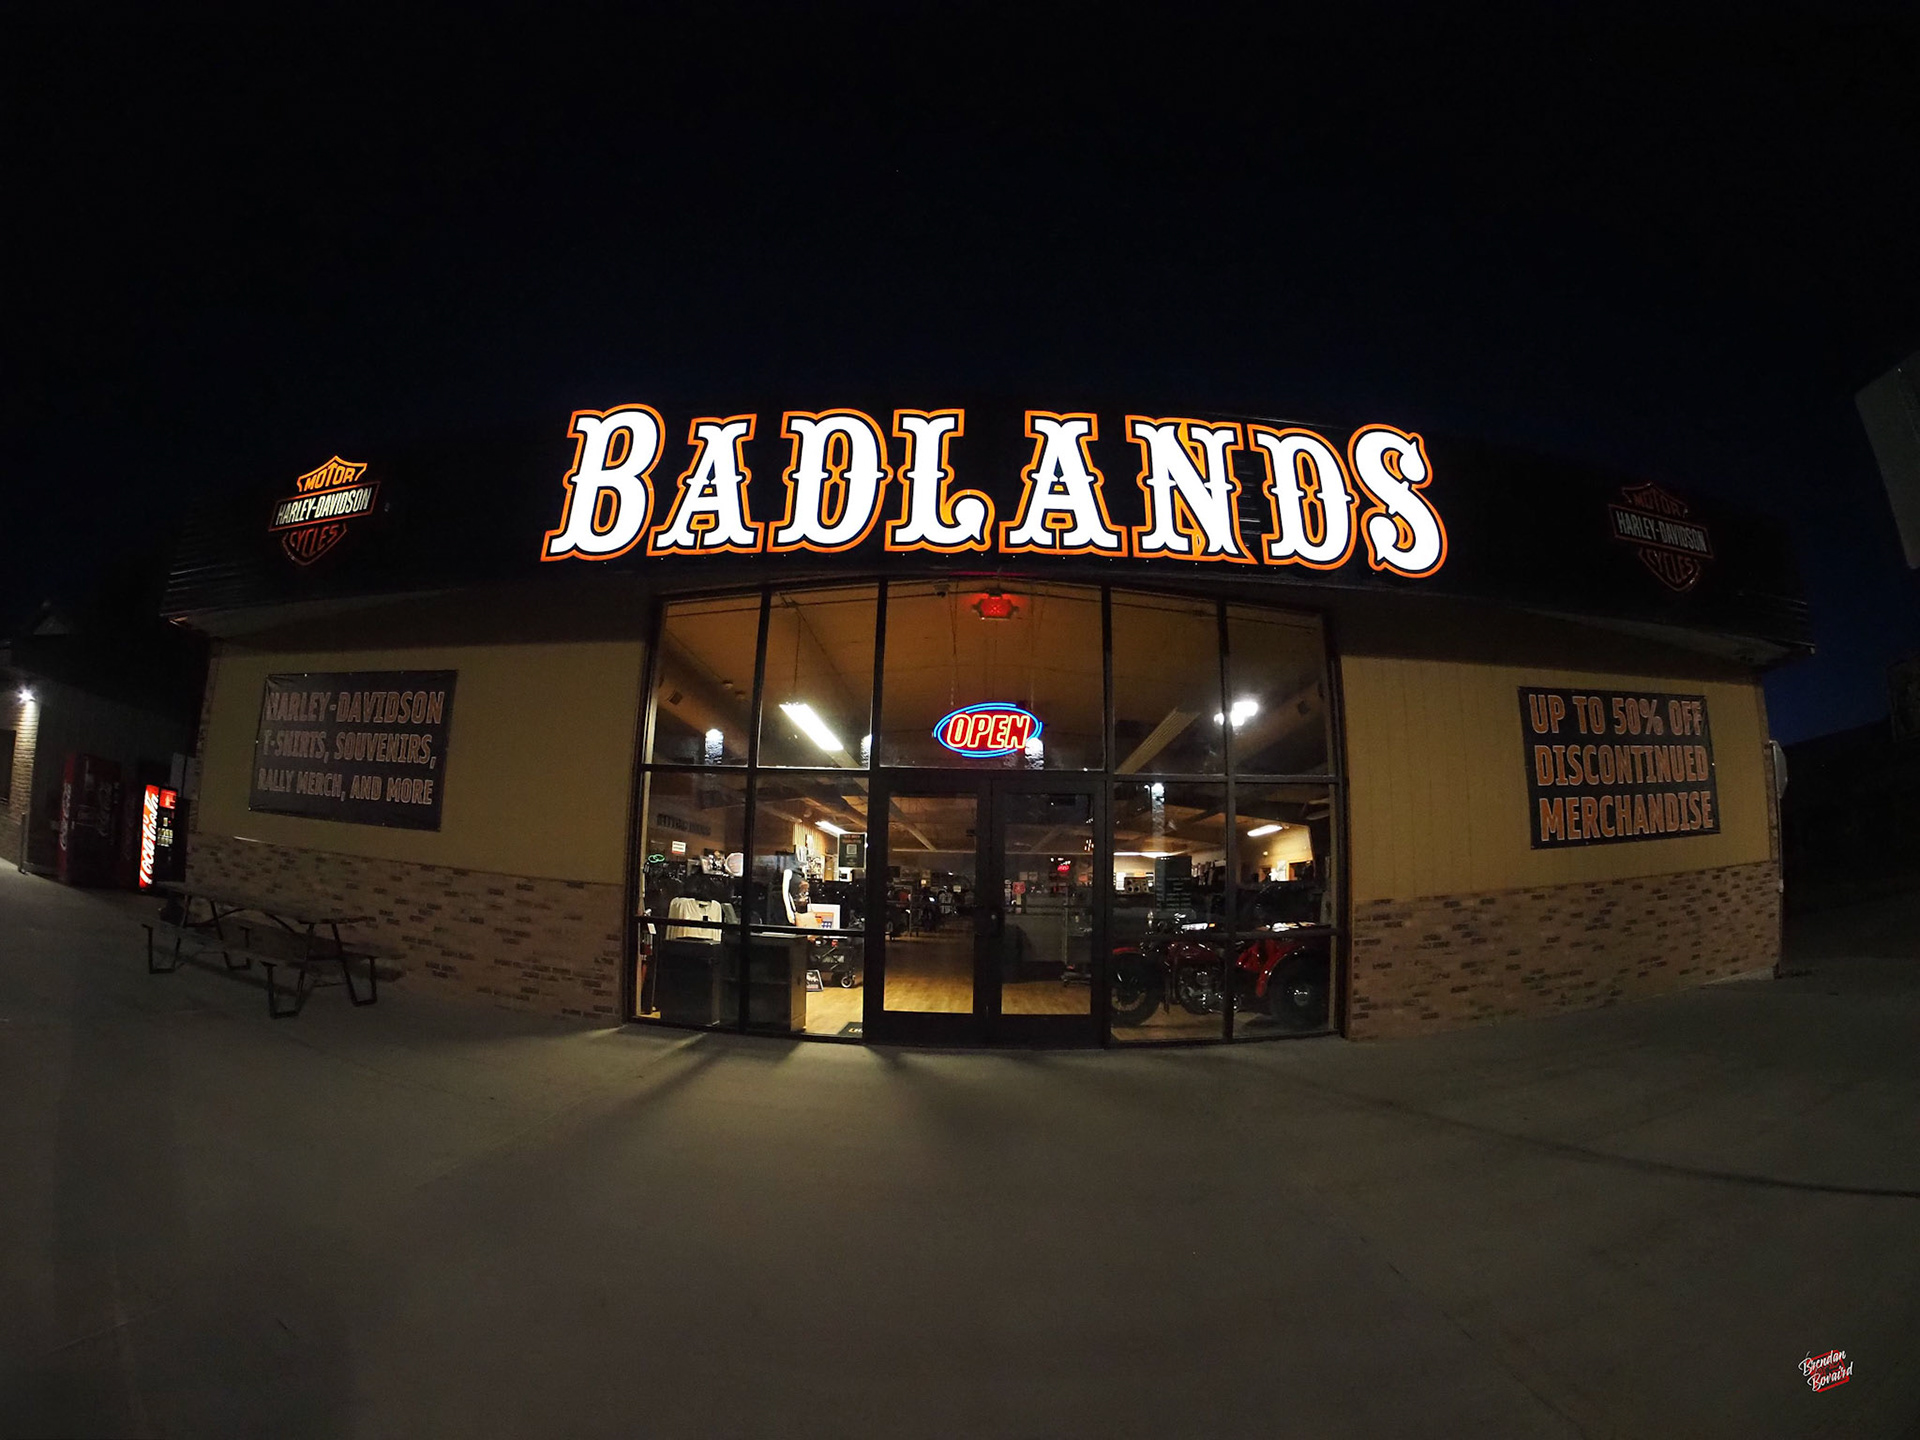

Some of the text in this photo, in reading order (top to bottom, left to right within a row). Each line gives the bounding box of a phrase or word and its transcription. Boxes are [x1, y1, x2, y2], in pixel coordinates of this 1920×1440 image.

[304, 462, 356, 492] MOTOR
[541, 403, 1447, 578] BADLANDS
[275, 487, 373, 525] HARLEY-DAVIDSON
[1632, 488, 1681, 517] MOTOR
[289, 524, 340, 558] CYCLES
[1615, 510, 1708, 553] HARLEY-DAVIDSON
[1646, 548, 1694, 583] CYCLES
[264, 691, 445, 725] HARLEY-DAVIDSON
[1529, 694, 1704, 736] UP TO 50% OFF
[263, 729, 437, 769] T-SHIRTS, SOUVENIRS,
[946, 713, 1031, 749] OPEN
[1534, 744, 1709, 786] DISCONTINUED
[258, 767, 434, 805] RALLY MERCH, AND MORE
[1538, 790, 1714, 841] MERCHANDISE
